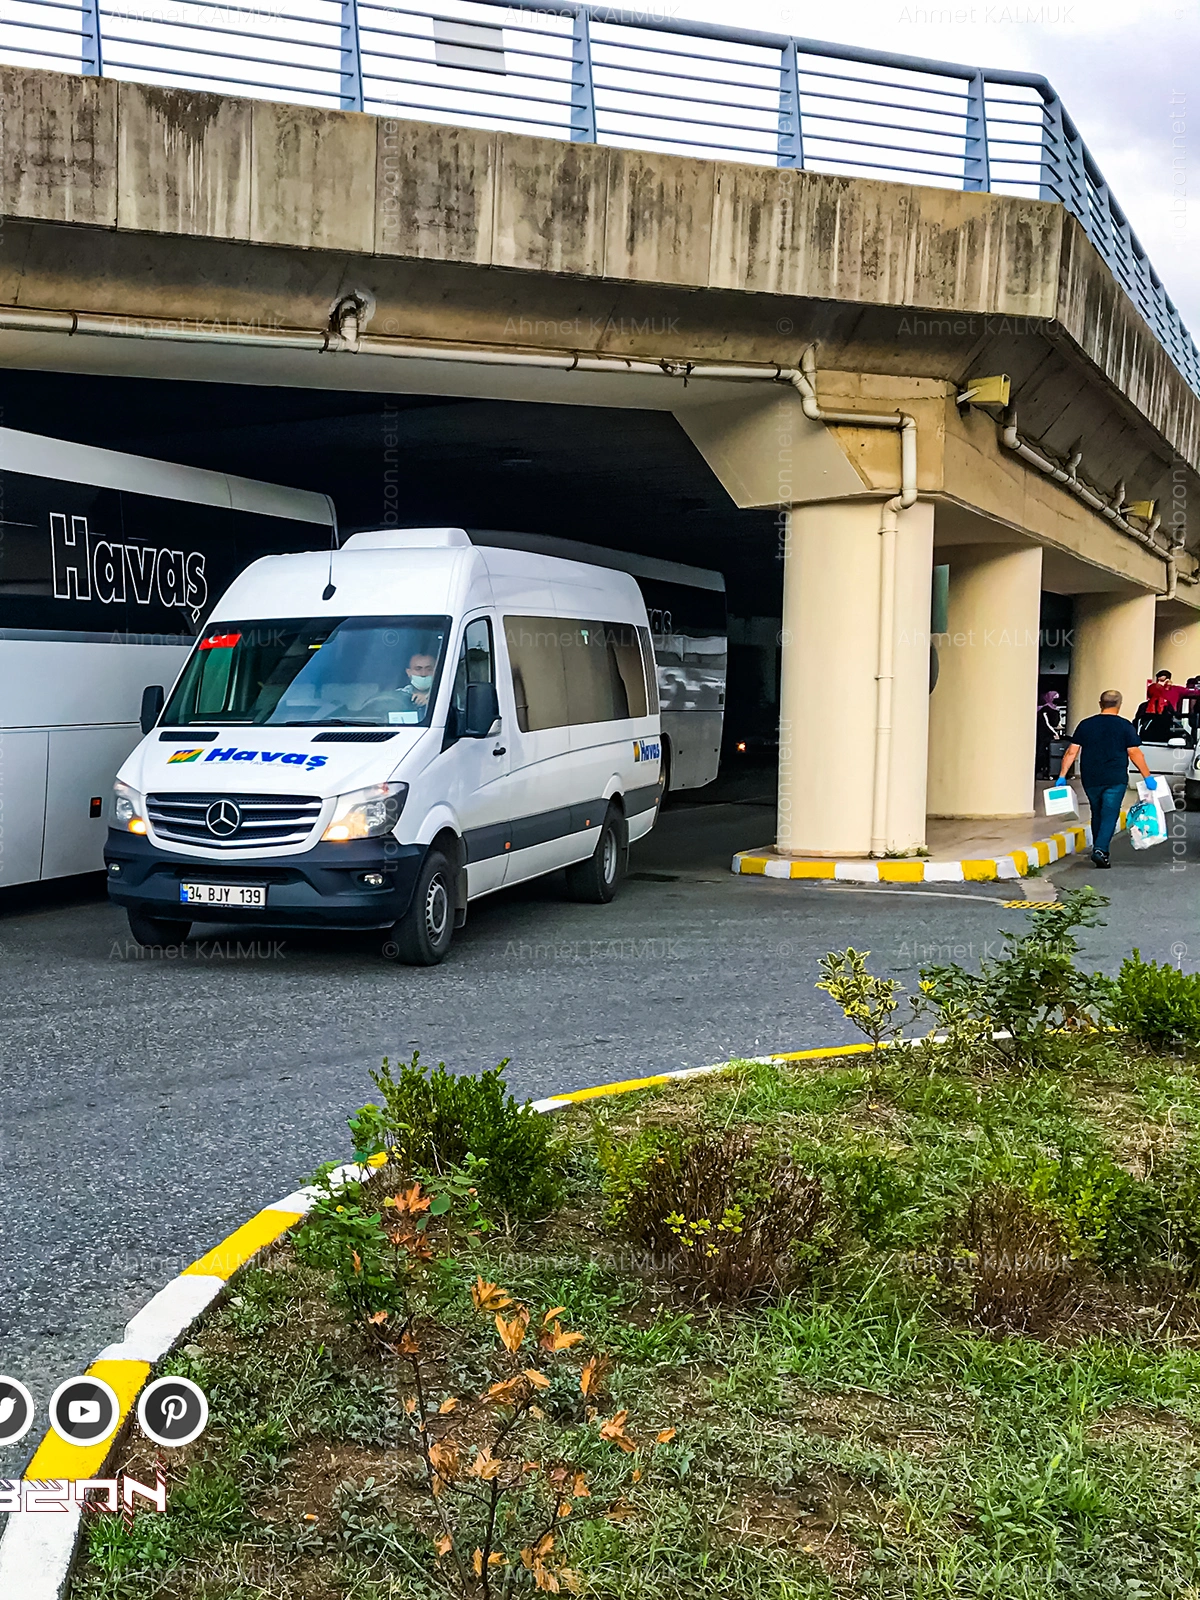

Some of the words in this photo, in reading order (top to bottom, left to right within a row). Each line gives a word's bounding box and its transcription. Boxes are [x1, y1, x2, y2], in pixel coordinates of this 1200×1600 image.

[49, 512, 208, 624] Havaş
[204, 747, 329, 771] Havaş
[188, 886, 202, 901] 34
[208, 887, 230, 902] BJY
[240, 889, 261, 904] 139
